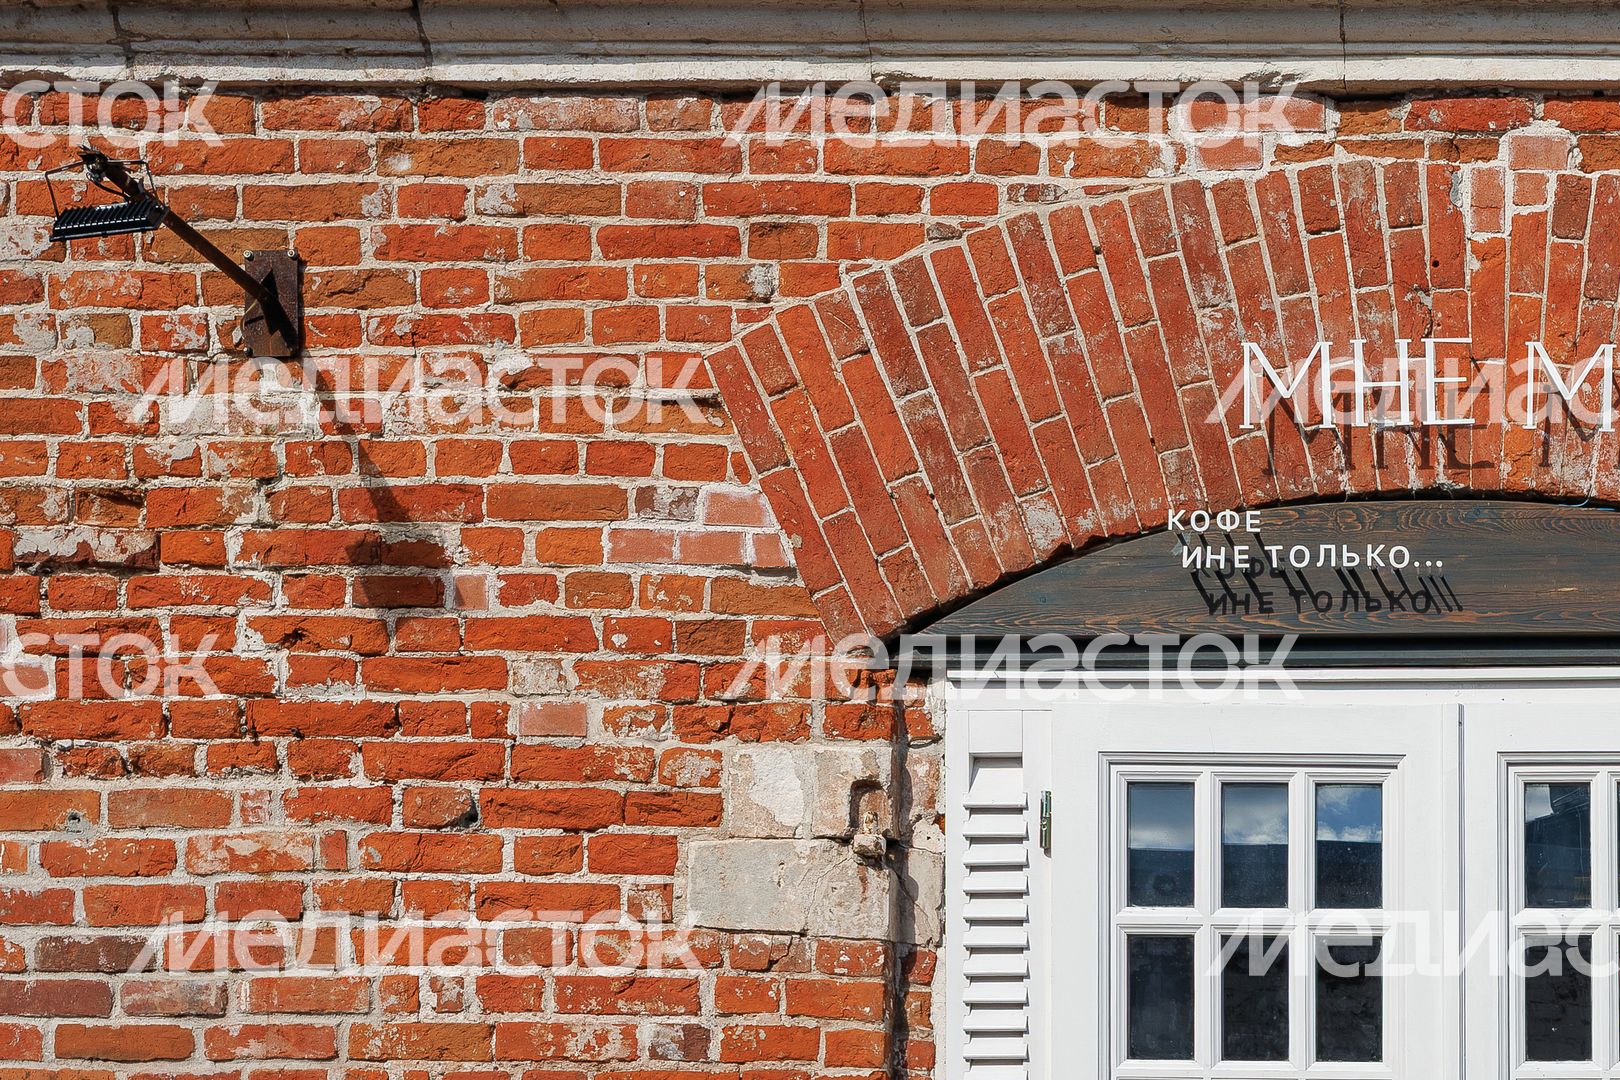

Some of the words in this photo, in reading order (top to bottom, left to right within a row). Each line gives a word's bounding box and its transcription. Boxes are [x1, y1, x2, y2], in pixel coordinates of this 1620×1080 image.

[1240, 337, 1475, 430] МНЕ
[1168, 509, 1261, 532] КОФЕ
[1264, 544, 1444, 569] ТОЛЬКО...
